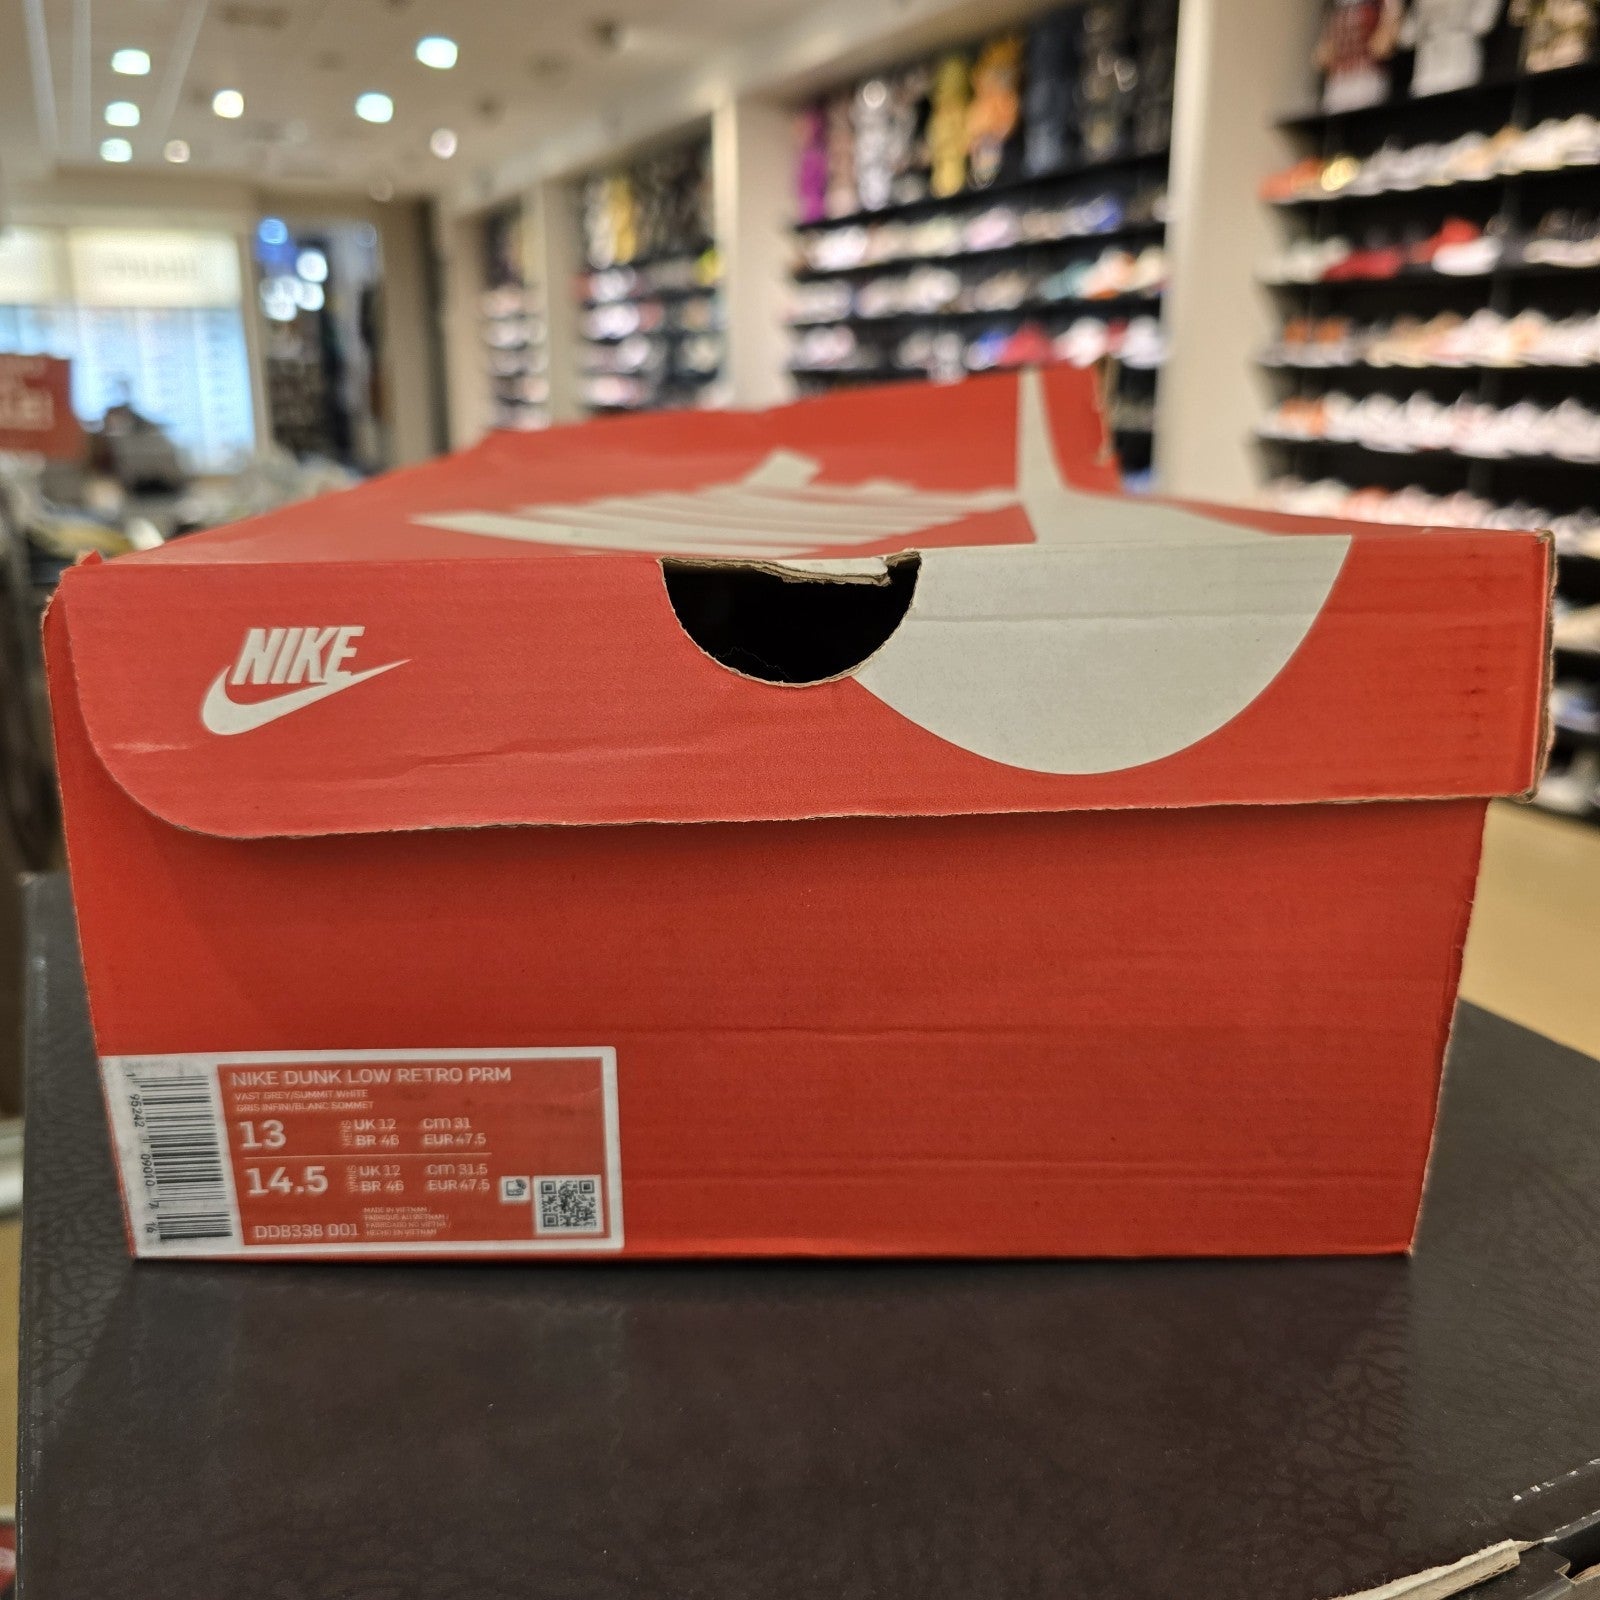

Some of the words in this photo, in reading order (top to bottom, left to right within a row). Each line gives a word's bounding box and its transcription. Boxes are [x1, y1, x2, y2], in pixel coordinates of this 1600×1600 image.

[231, 626, 365, 685] NIKE
[231, 1071, 280, 1086] NIKE
[284, 1070, 342, 1085] DUNK
[348, 1068, 392, 1083] LOW
[397, 1067, 464, 1083] RETRO
[468, 1067, 512, 1082] PRM
[234, 1092, 260, 1101] VAST
[263, 1090, 335, 1100] GREY/SUMMIT
[336, 1089, 369, 1099] WHITE
[331, 1101, 374, 1110] SOMMET
[354, 1119, 376, 1130] UK
[378, 1118, 397, 1129] 12
[454, 1117, 472, 1129] 31
[129, 1093, 146, 1128] 95242
[140, 1153, 156, 1187] 09010
[238, 1119, 287, 1149] 13
[355, 1134, 377, 1146] BR
[380, 1134, 400, 1146] 46
[423, 1133, 454, 1146] EUR
[456, 1132, 487, 1145] 47.5
[360, 1165, 382, 1176] UK
[383, 1164, 401, 1176] 12
[458, 1162, 488, 1175] 31.5
[245, 1165, 329, 1194] 14.5
[361, 1180, 382, 1192] BR
[384, 1179, 405, 1191] 46
[427, 1179, 458, 1191] EUR
[460, 1178, 491, 1191] 47.5
[327, 1223, 361, 1236] 001
